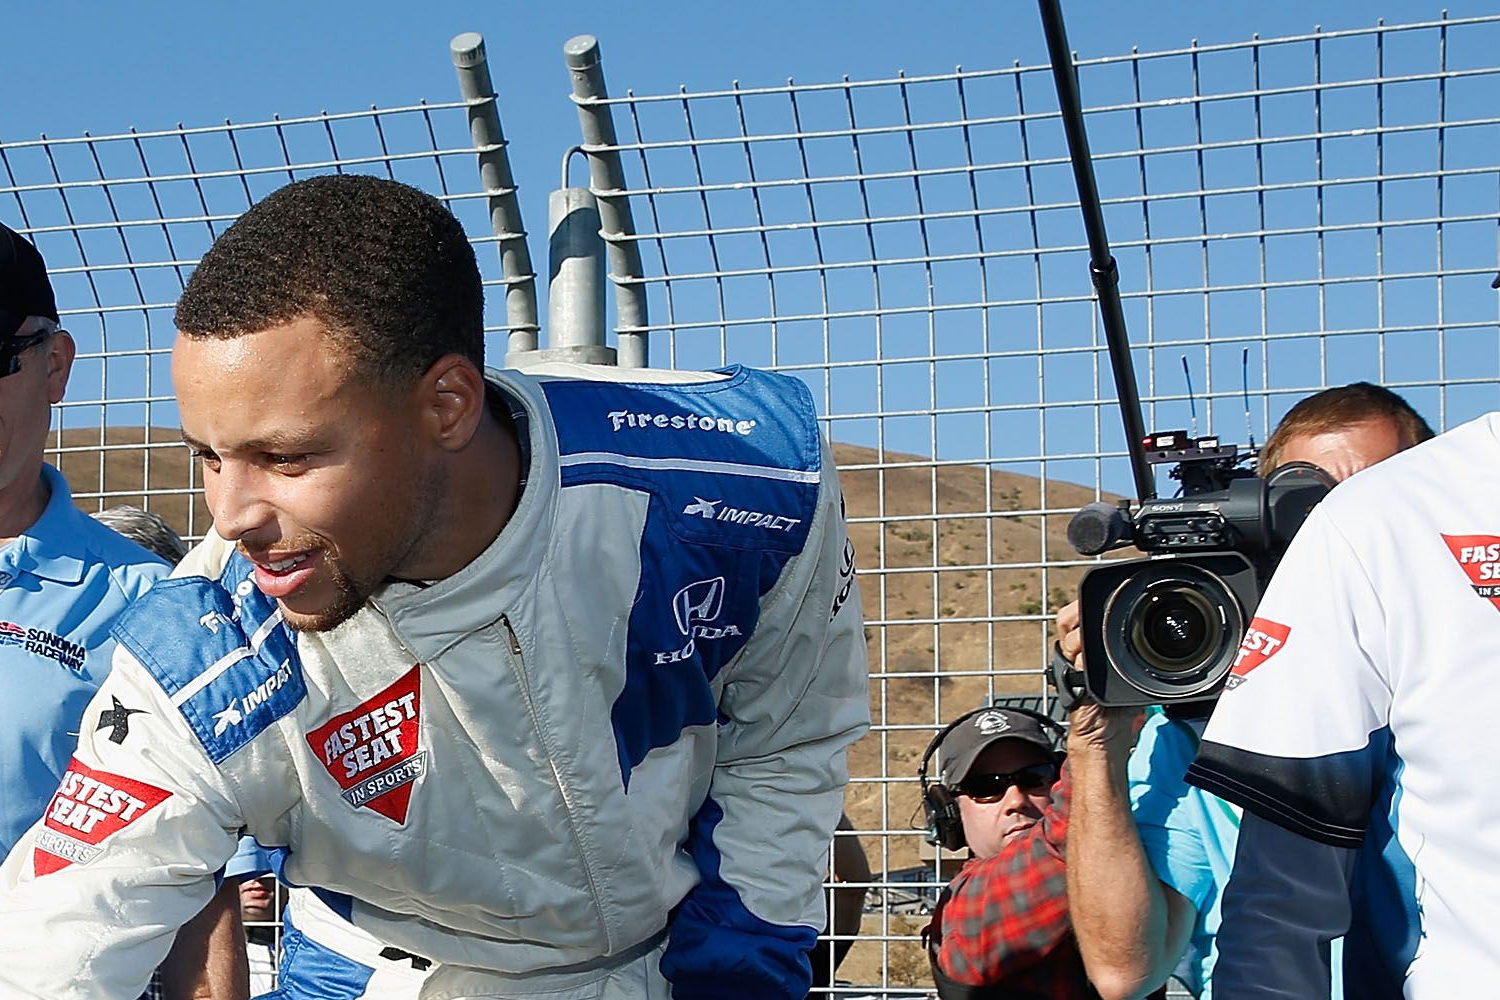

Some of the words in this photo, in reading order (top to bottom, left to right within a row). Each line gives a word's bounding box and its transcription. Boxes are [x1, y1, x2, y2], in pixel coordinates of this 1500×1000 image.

[607, 410, 757, 435] Firestone
[716, 506, 801, 532] IMPACT
[1151, 503, 1184, 511] SONY
[24, 640, 85, 671] RACEWAY
[27, 628, 87, 660] SONOMA
[654, 625, 743, 665] HODA
[323, 691, 417, 766] FASTEST
[342, 728, 404, 778] SEAT
[350, 787, 366, 805] IN
[367, 757, 423, 795] SPORTS
[48, 796, 108, 835] SEAT
